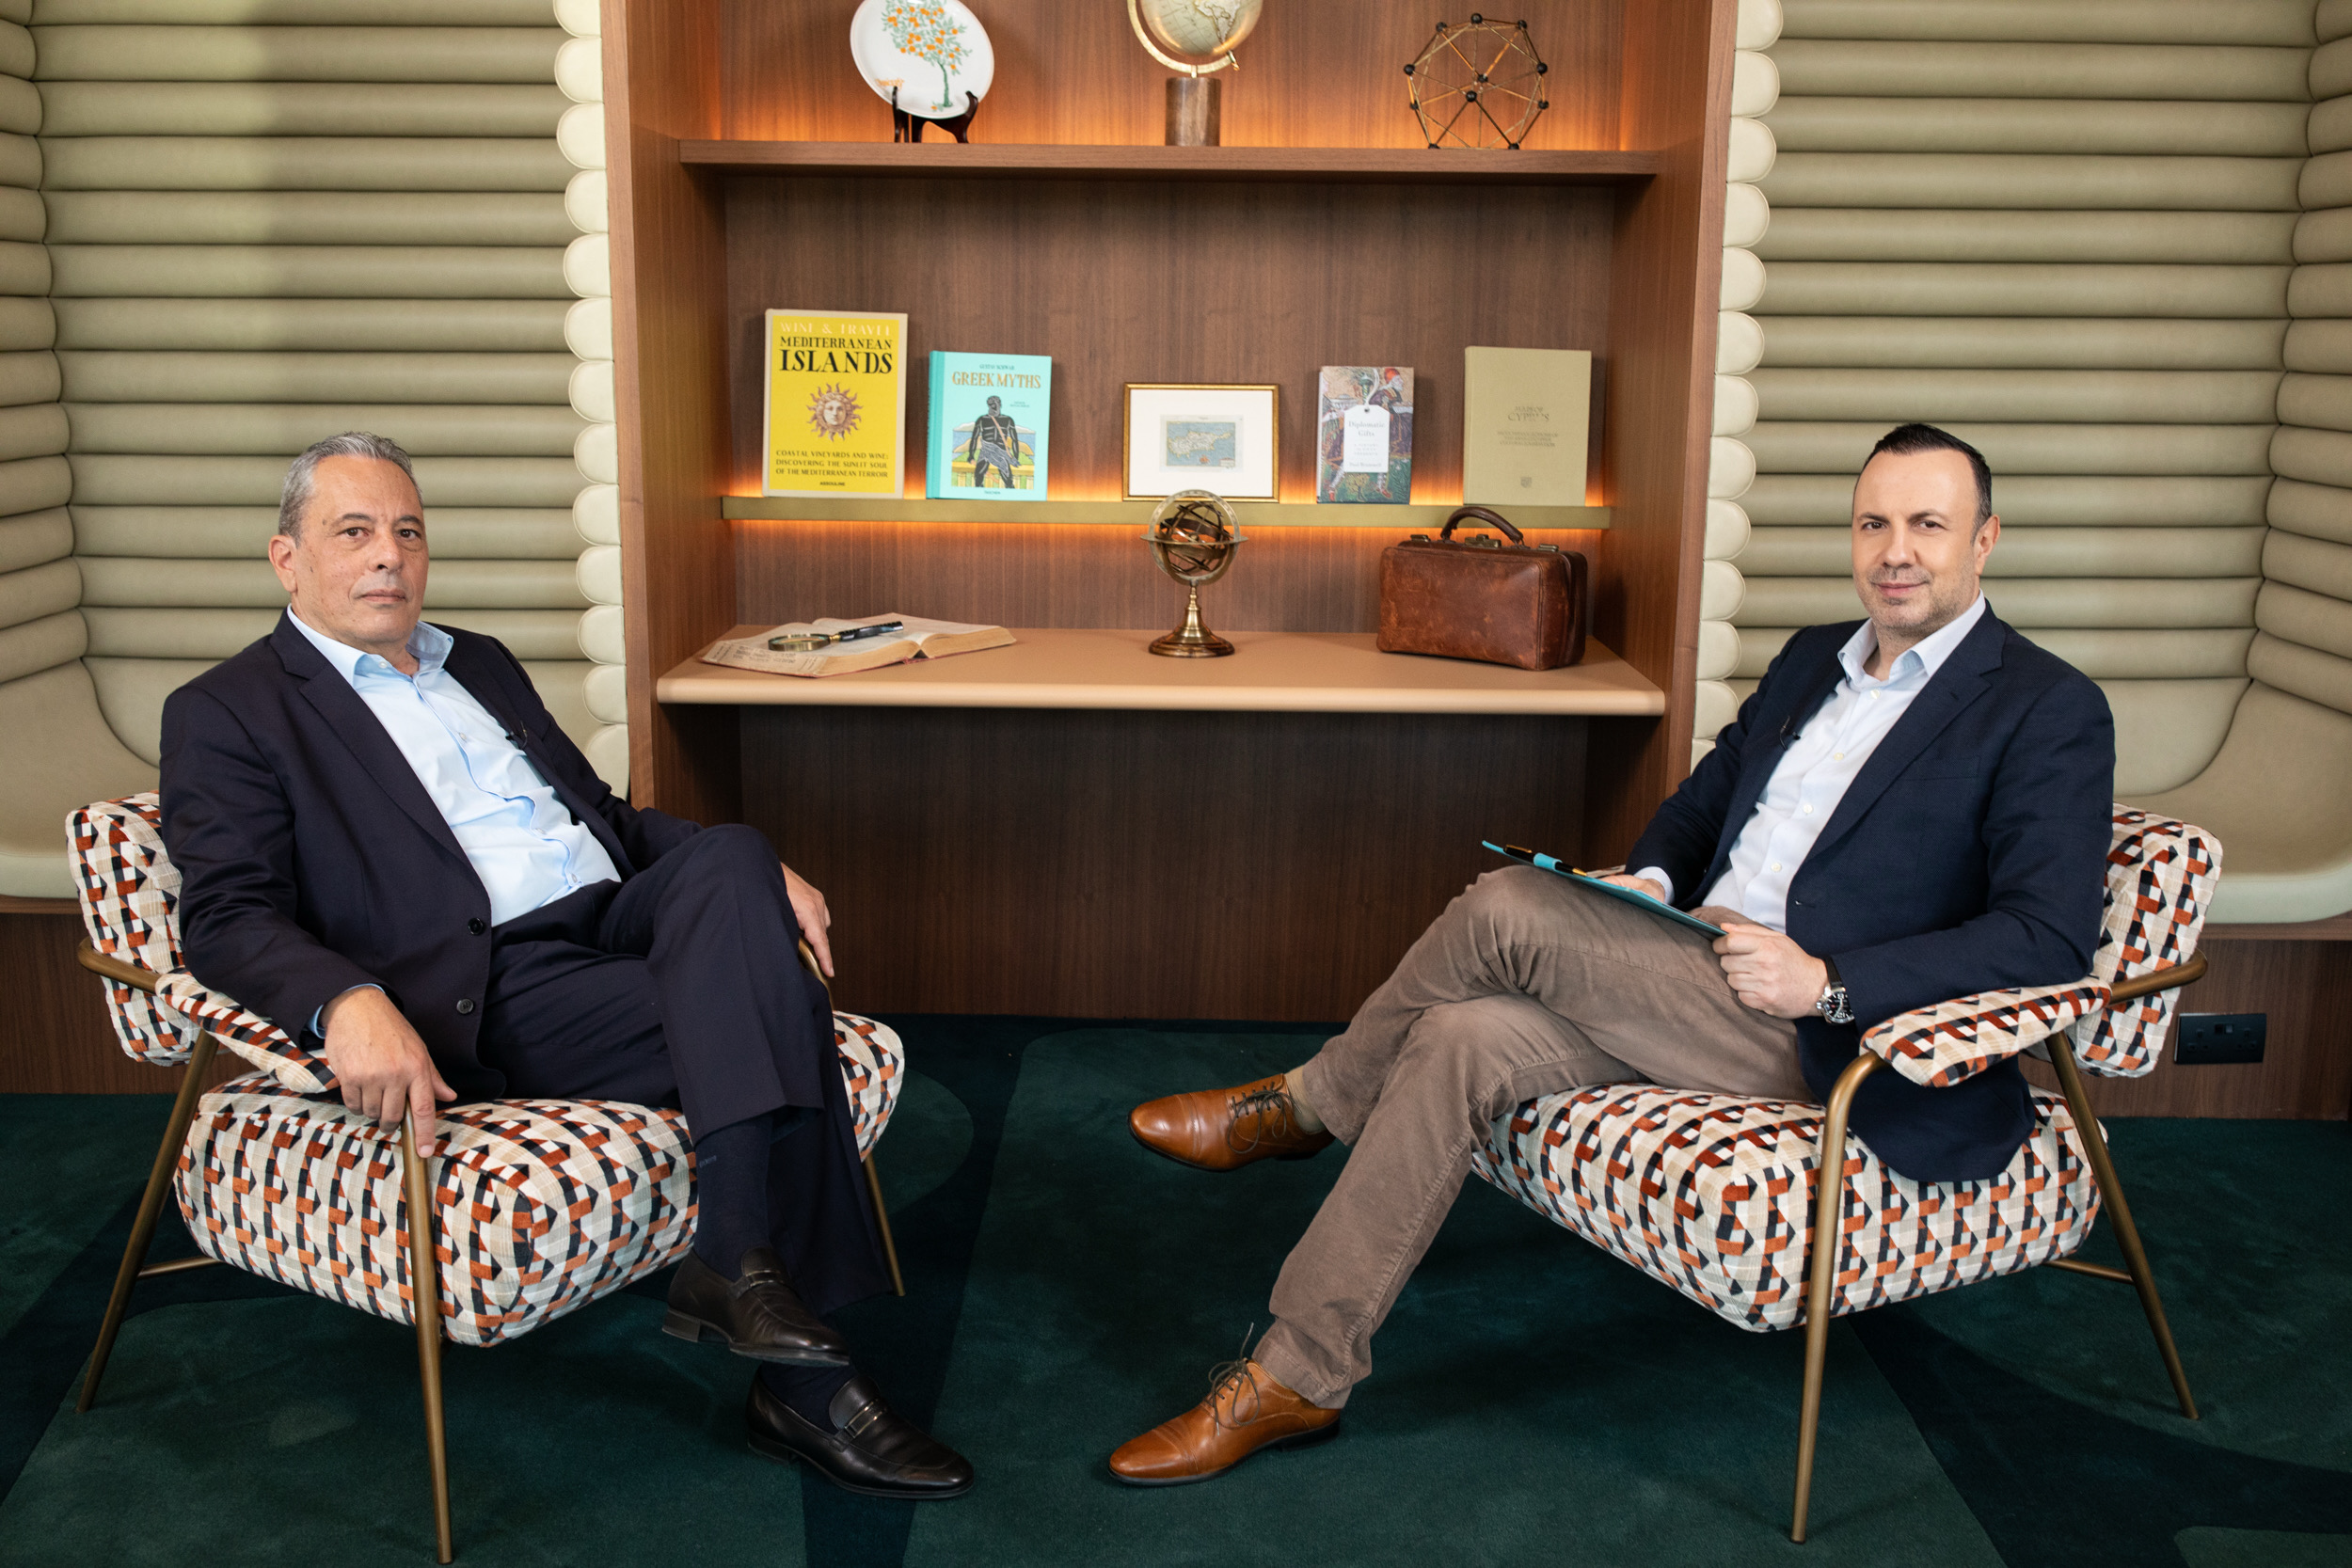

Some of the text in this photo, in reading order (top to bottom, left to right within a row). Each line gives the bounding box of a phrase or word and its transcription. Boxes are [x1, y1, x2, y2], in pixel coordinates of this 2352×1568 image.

[780, 323, 891, 336] WINE & TRAVEL
[780, 336, 893, 350] MEDITERRANEAN
[779, 349, 893, 374] ISLANDS
[952, 372, 1041, 388] GREEK MYTHS
[776, 450, 809, 458] COASTAL
[810, 451, 850, 459] VINEYARDS
